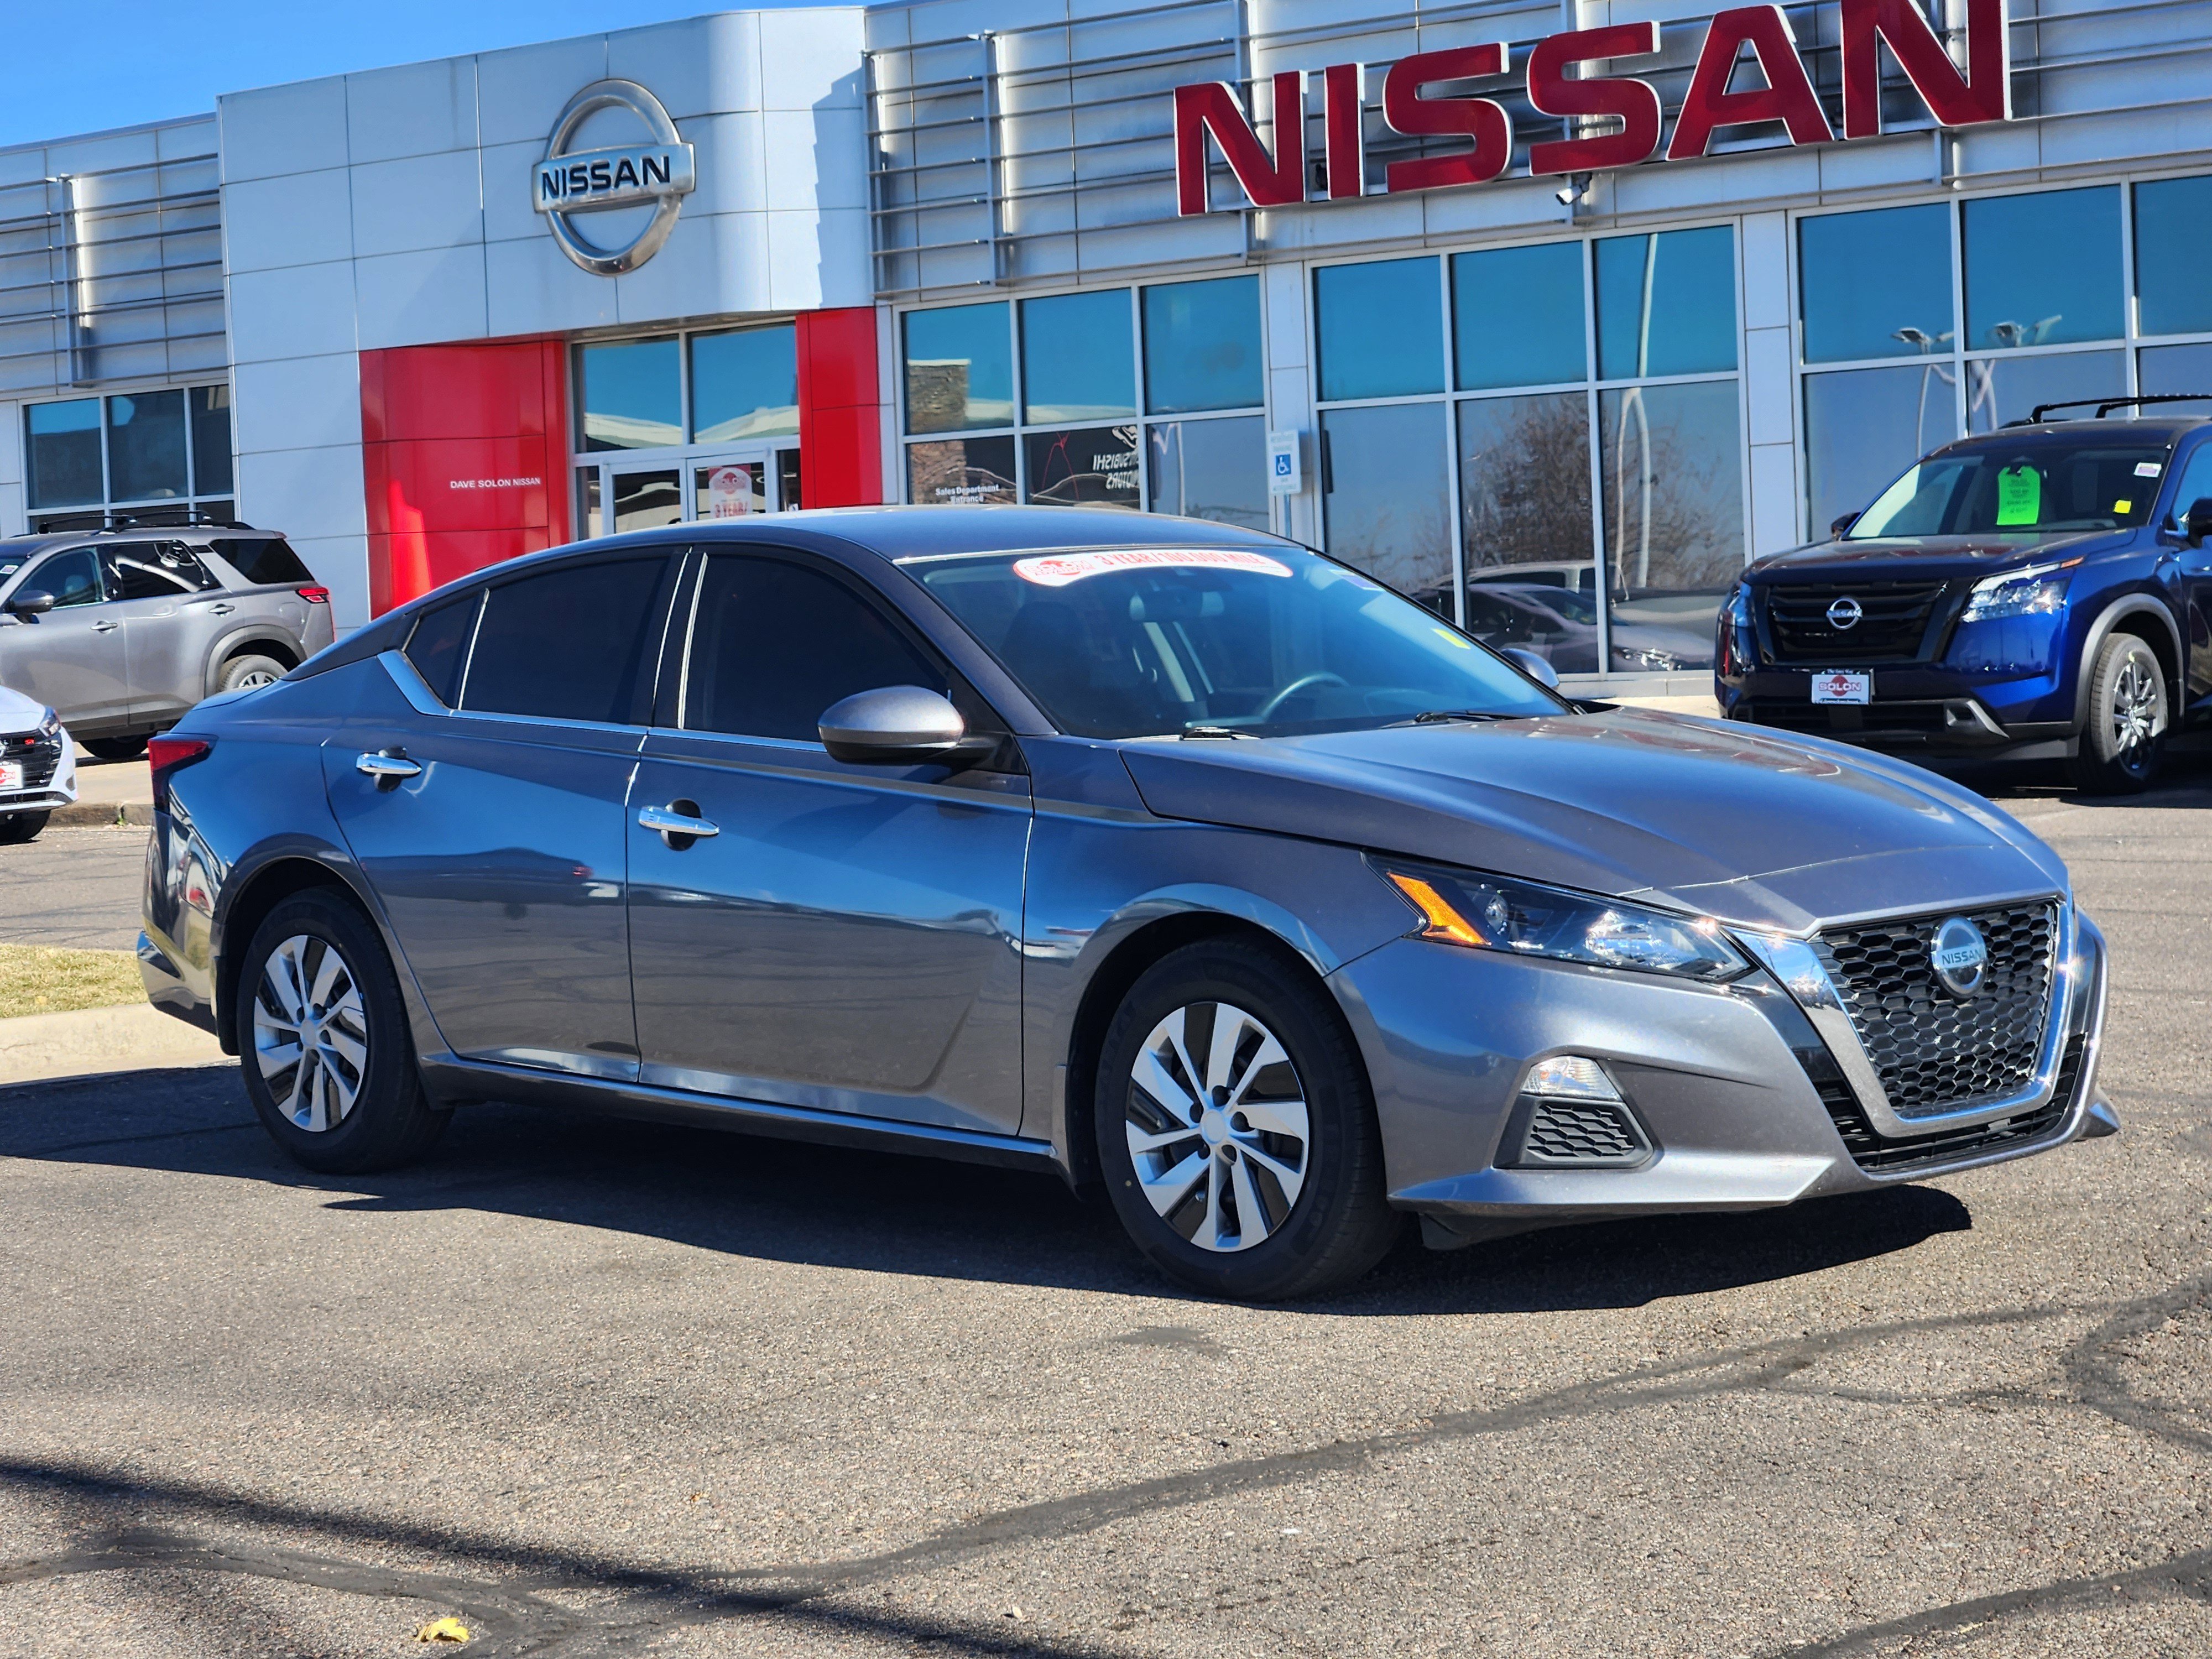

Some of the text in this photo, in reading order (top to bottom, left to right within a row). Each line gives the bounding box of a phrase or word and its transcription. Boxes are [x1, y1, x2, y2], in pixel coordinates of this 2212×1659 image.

[1173, 0, 2013, 217] NISSAN
[542, 155, 671, 201] NISSAN
[478, 479, 511, 488] SOLON
[513, 477, 541, 486] NISSAN
[936, 484, 1000, 495] Sales Department
[950, 495, 984, 504] Entrance
[1818, 682, 1862, 692] SOLON
[1942, 949, 1982, 965] NISSAN
